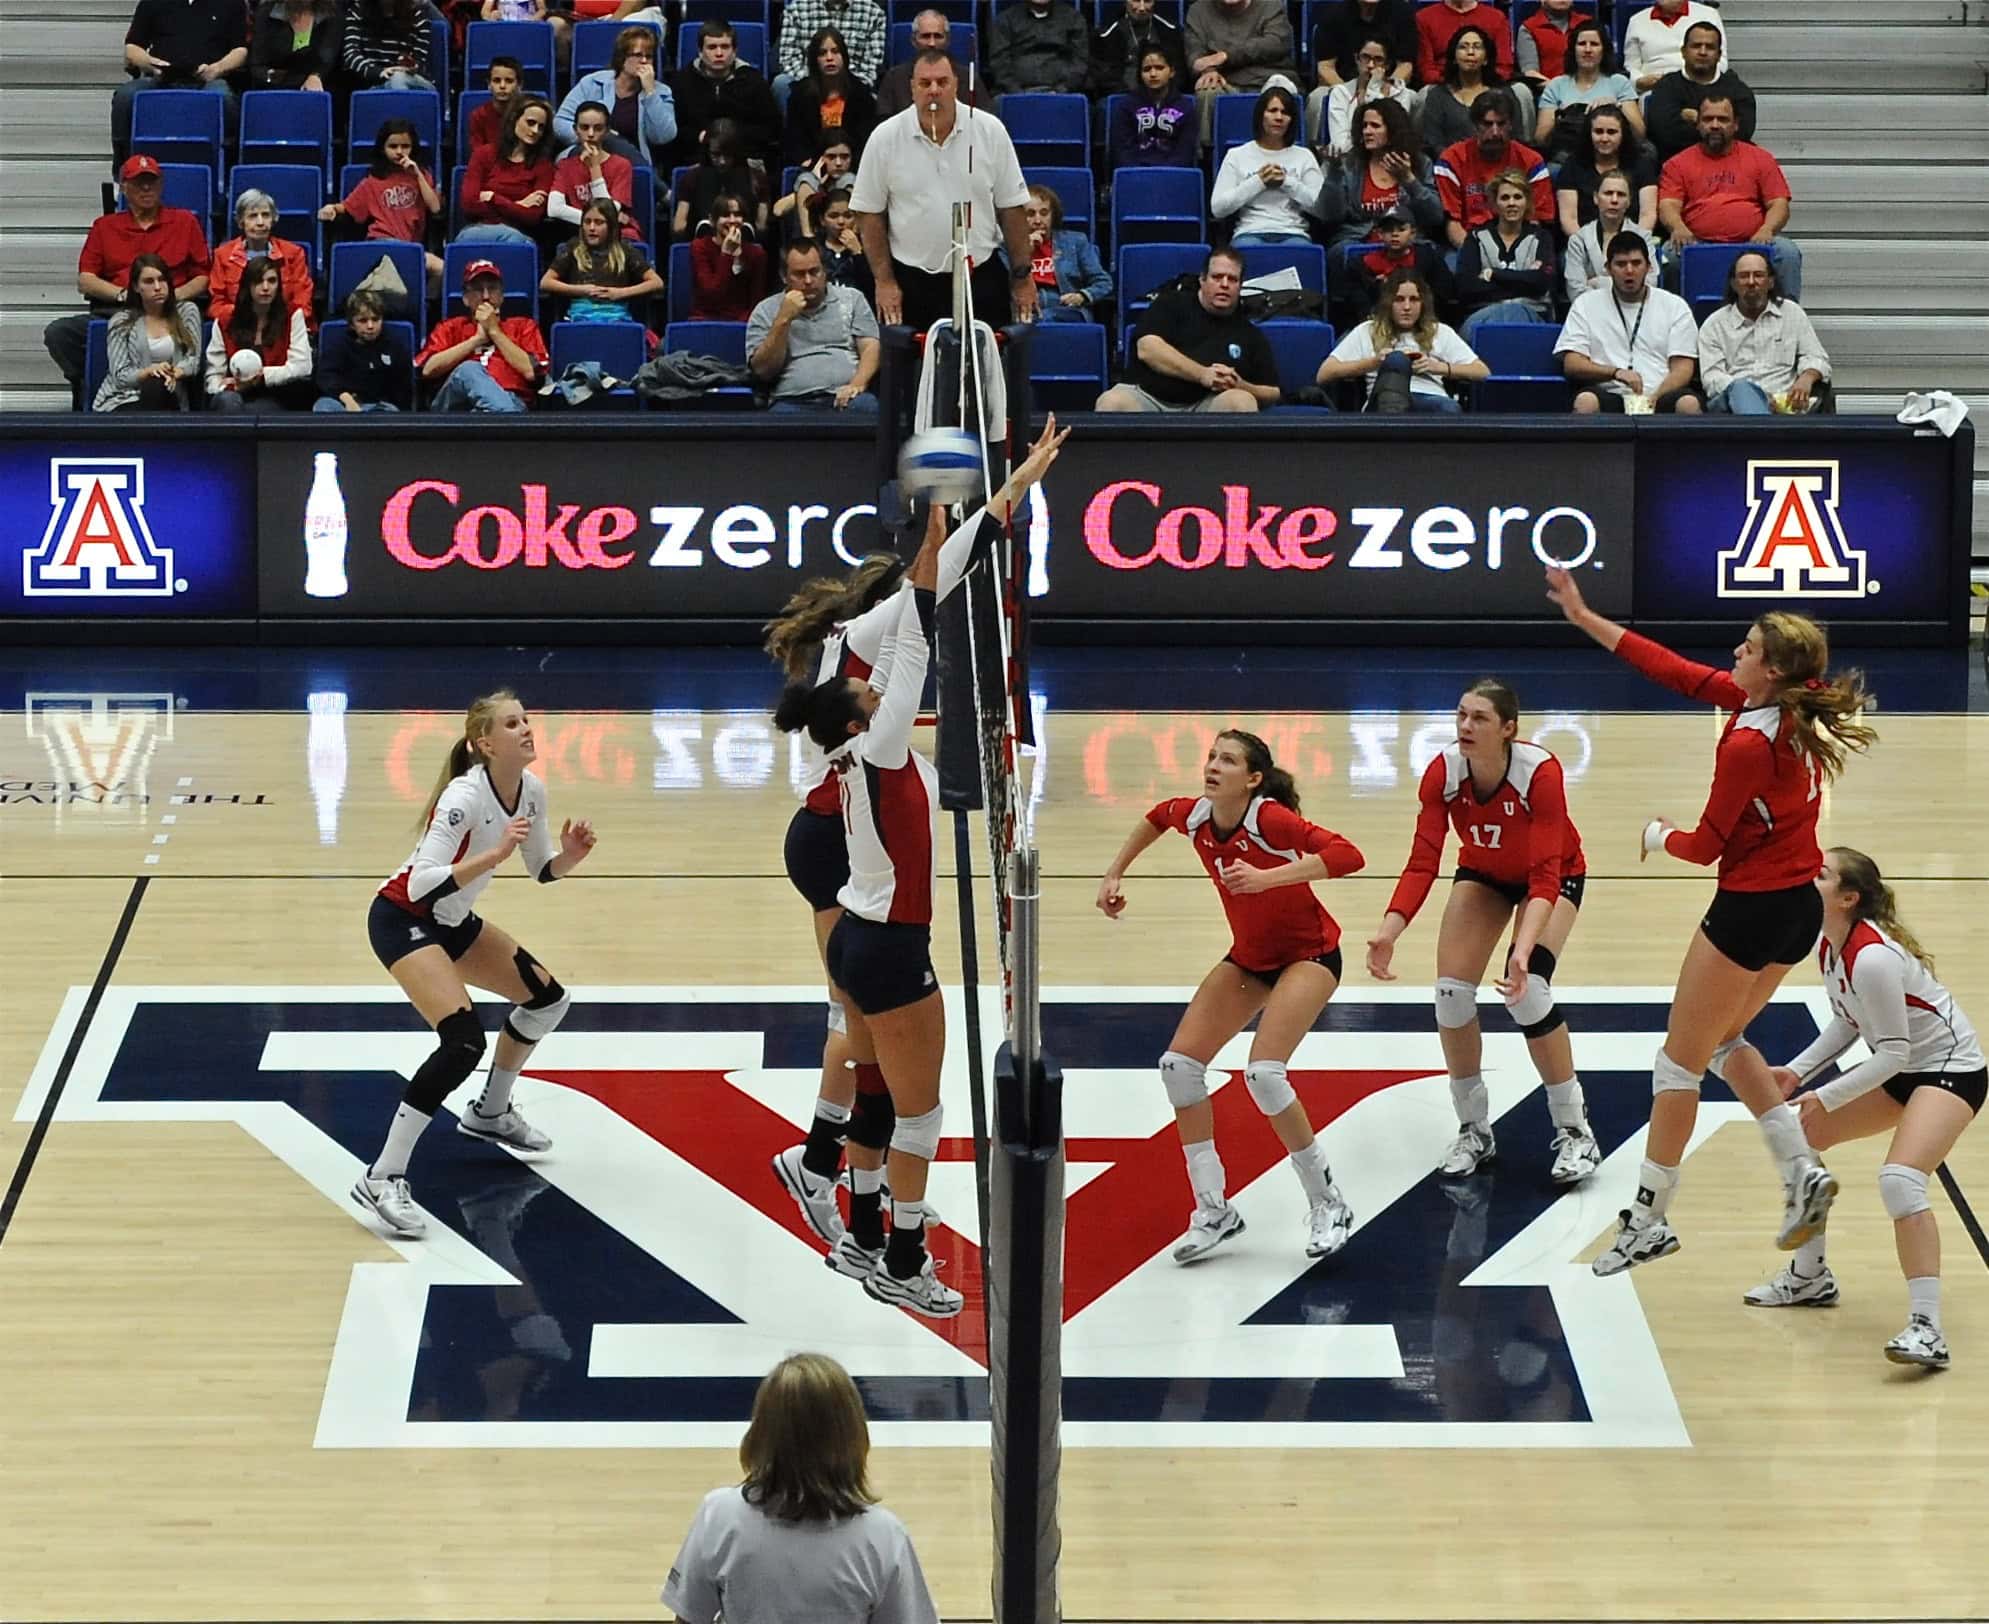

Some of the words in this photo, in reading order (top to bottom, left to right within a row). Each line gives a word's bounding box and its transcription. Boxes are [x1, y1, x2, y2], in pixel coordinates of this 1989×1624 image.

[23, 457, 174, 597] A
[381, 480, 638, 570] Coke
[1083, 481, 1337, 570] Coke
[1717, 460, 1867, 598] A
[1469, 824, 1502, 849] 17
